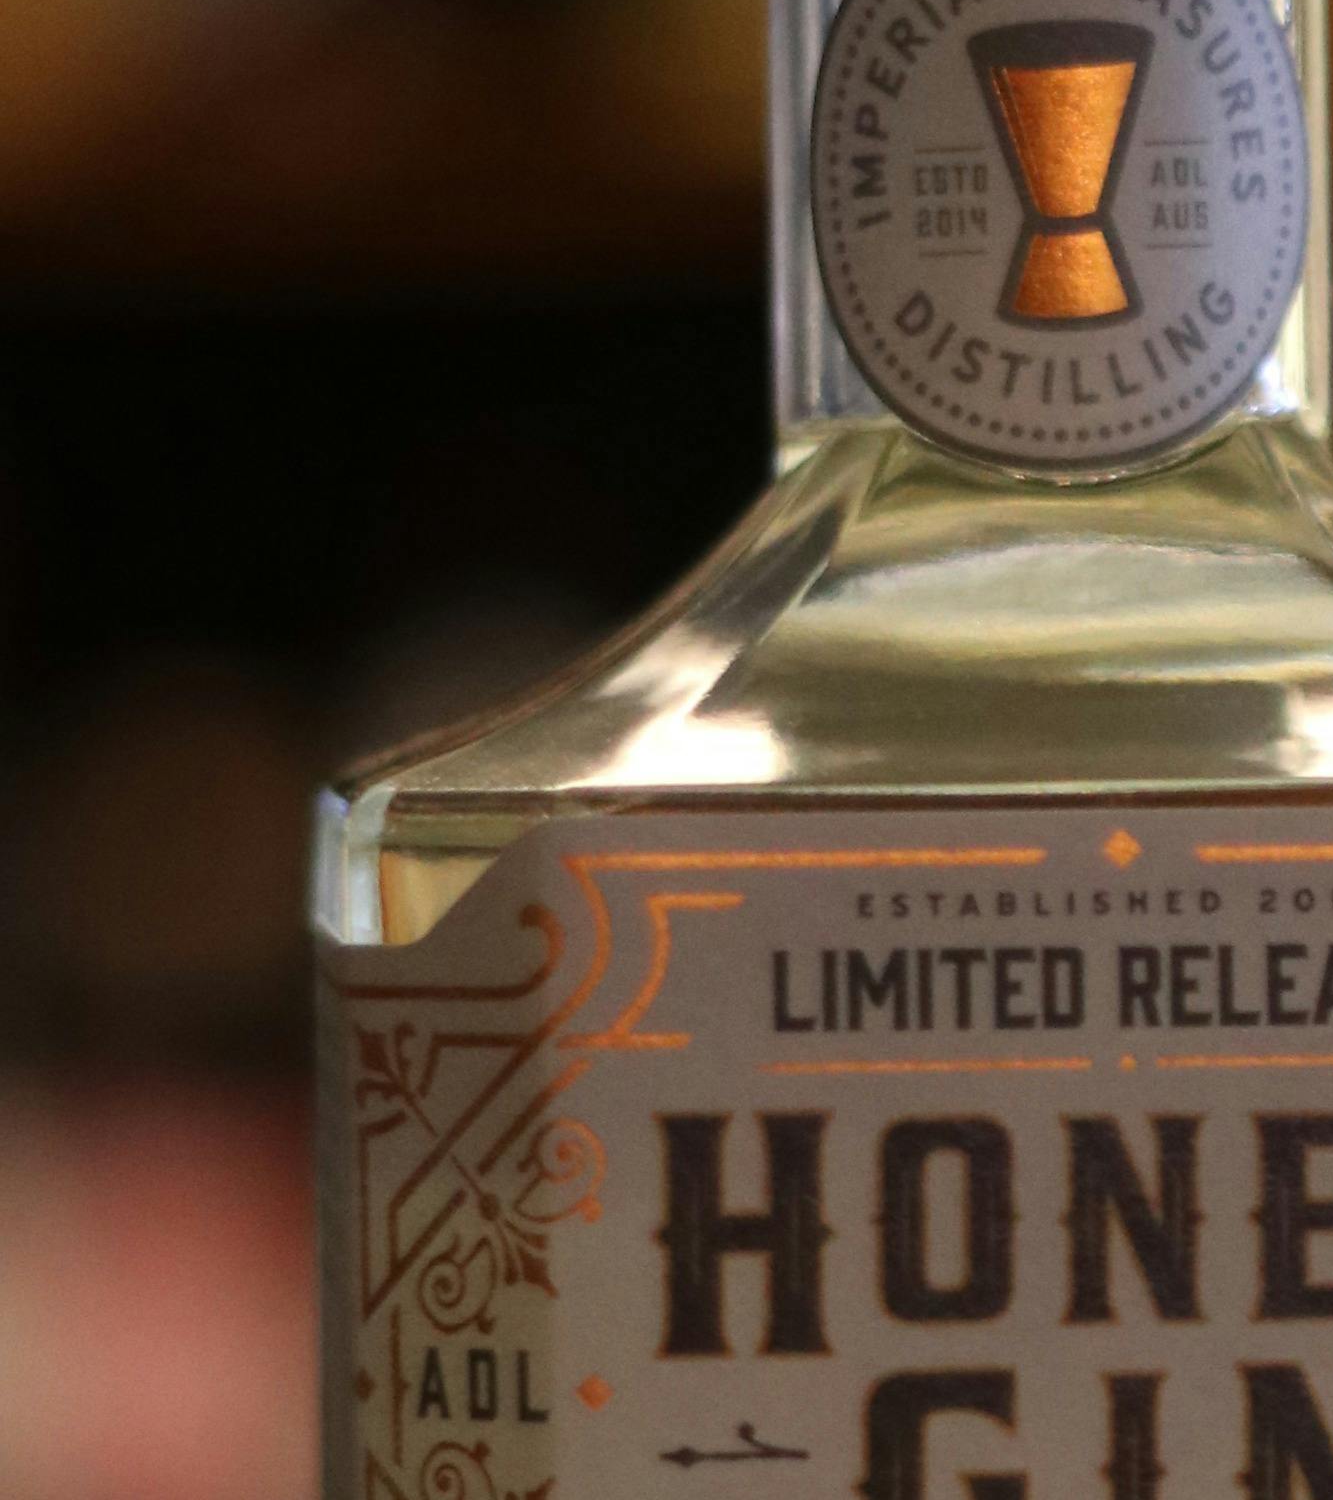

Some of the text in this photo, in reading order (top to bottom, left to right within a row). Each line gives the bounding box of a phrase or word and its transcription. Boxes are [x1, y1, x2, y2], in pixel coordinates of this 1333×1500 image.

[912, 160, 990, 197] ESTD
[1150, 155, 1209, 188] ADL
[912, 206, 990, 239] 2014
[1150, 200, 1210, 233] AUS
[892, 280, 1237, 406] DISTILLING
[856, 888, 1223, 919] ESTABLISHED
[771, 946, 1085, 1033] LIMITED
[416, 1346, 550, 1423] ADL
